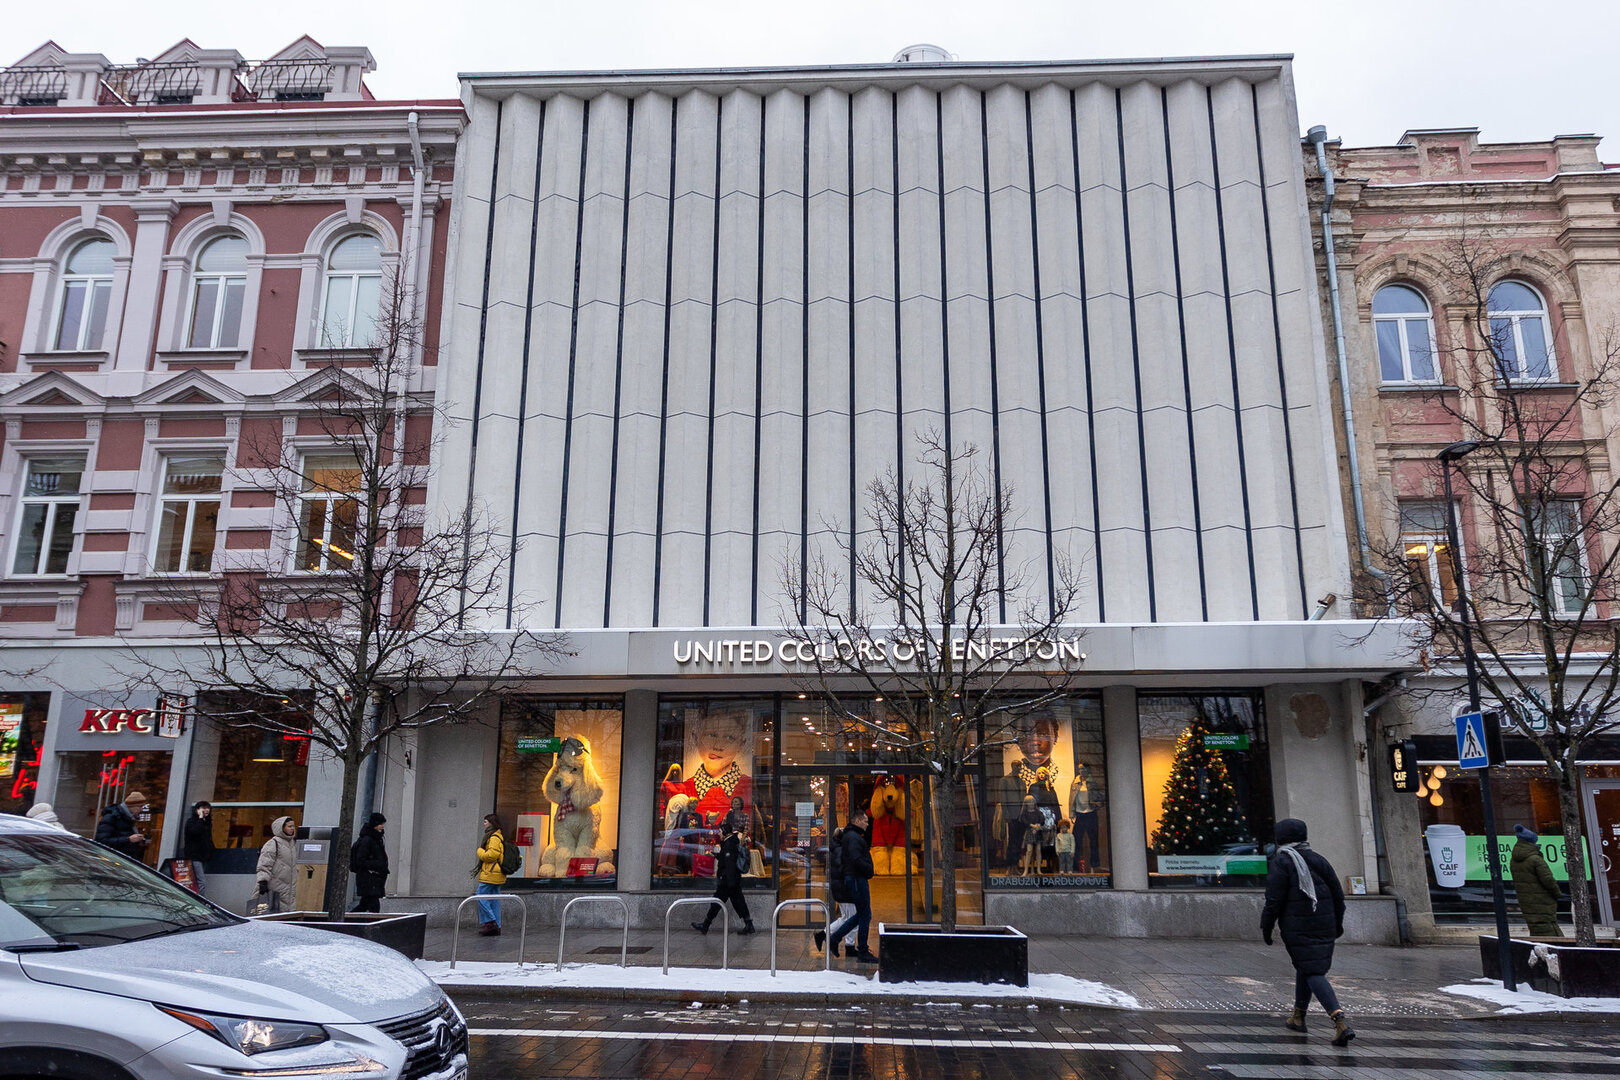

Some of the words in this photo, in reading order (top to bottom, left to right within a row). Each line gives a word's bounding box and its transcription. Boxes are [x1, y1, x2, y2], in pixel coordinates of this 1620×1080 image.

[673, 640, 774, 663] UNITED
[778, 639, 886, 662] COLORS
[78, 708, 155, 733] KFC
[1439, 863, 1459, 871] CAIF
